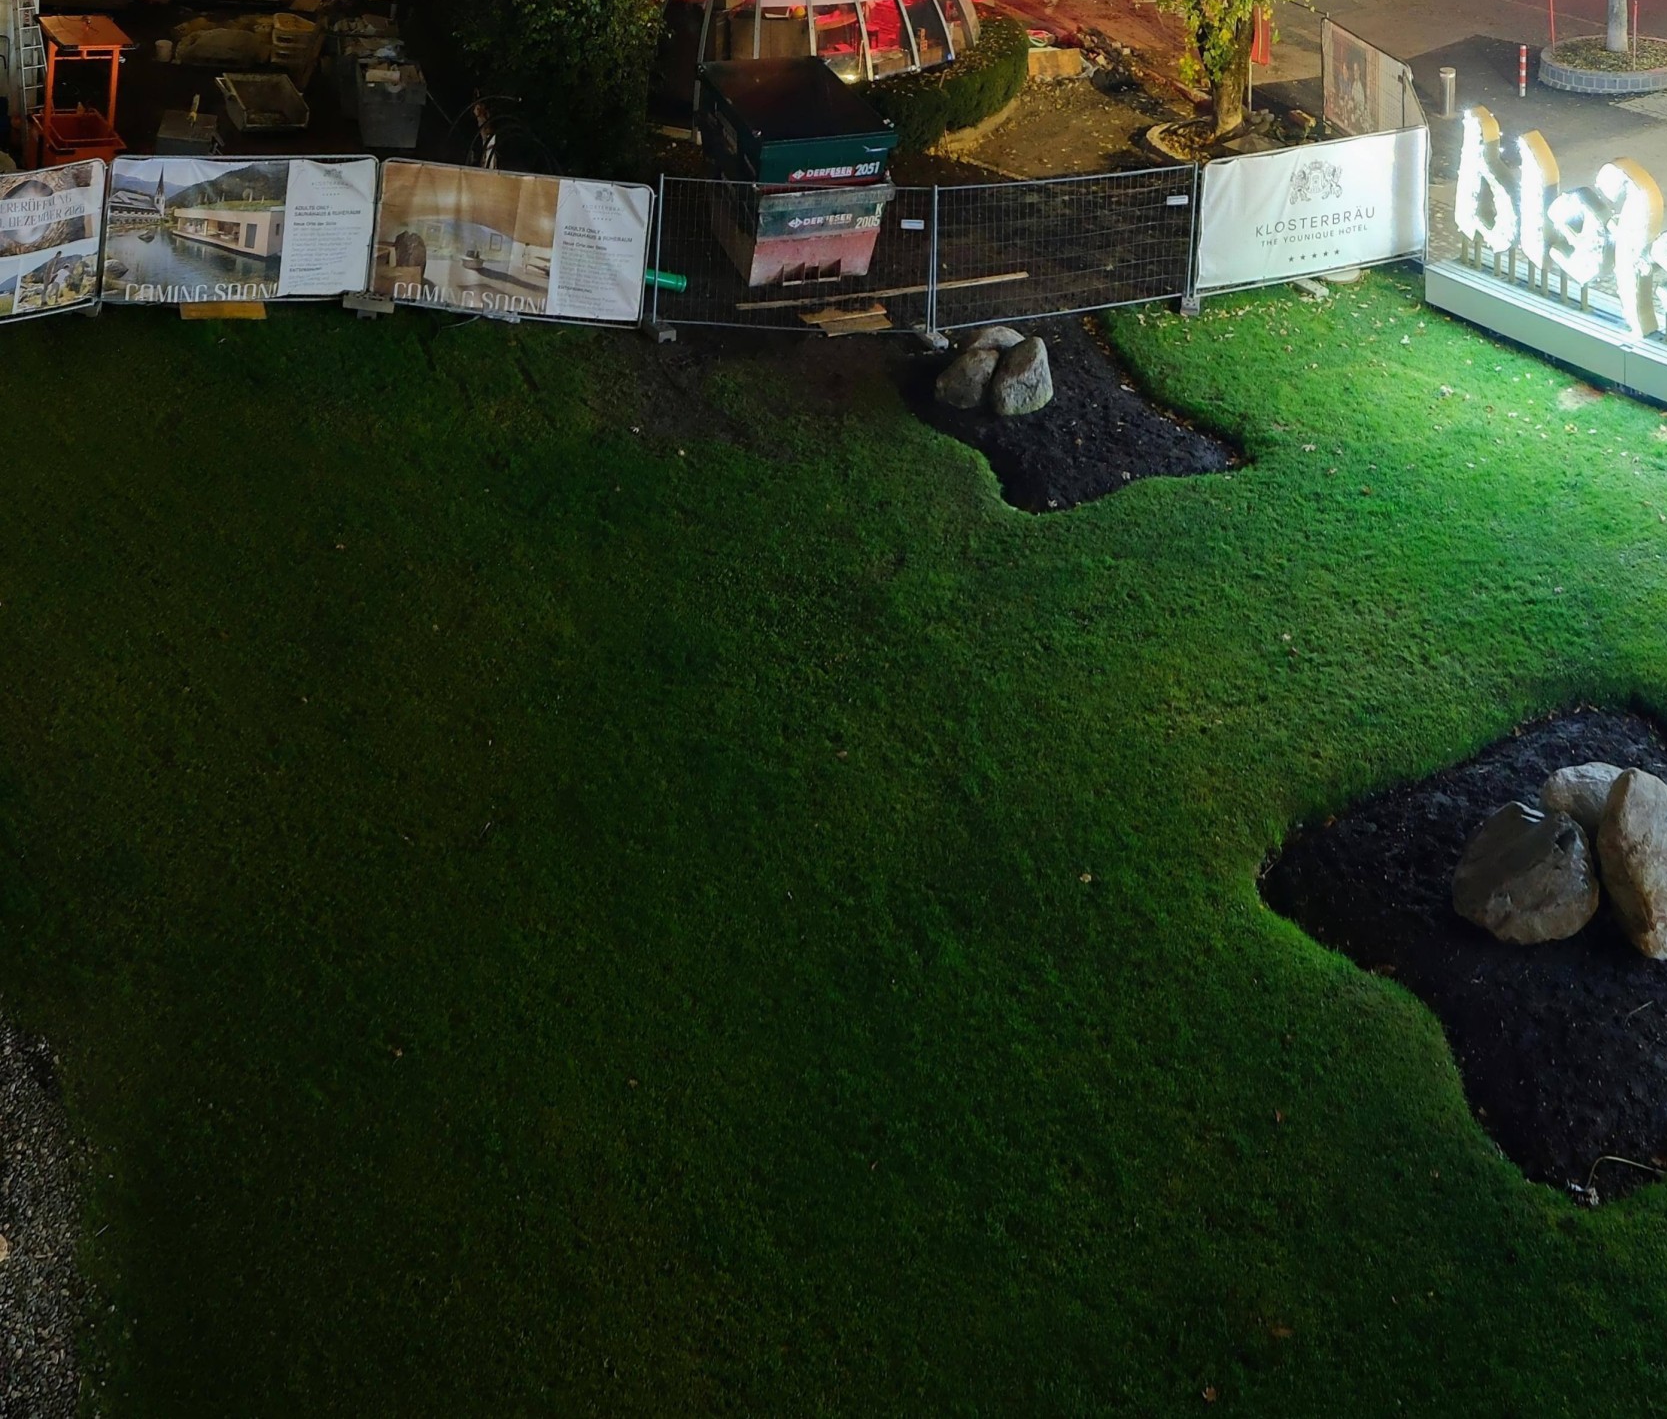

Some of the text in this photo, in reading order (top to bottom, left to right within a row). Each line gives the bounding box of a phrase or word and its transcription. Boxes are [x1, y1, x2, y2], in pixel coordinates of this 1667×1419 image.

[806, 161, 880, 178] DERFESER 2051
[875, 203, 884, 215] K
[855, 214, 881, 229] 2005
[1255, 205, 1375, 238] KLOSTERBRÄU
[1261, 224, 1368, 248] THE YOUNIQUE HOTEL
[125, 282, 278, 302] COMING SOON!
[393, 281, 475, 309] COMING
[481, 292, 548, 314] SOON!
